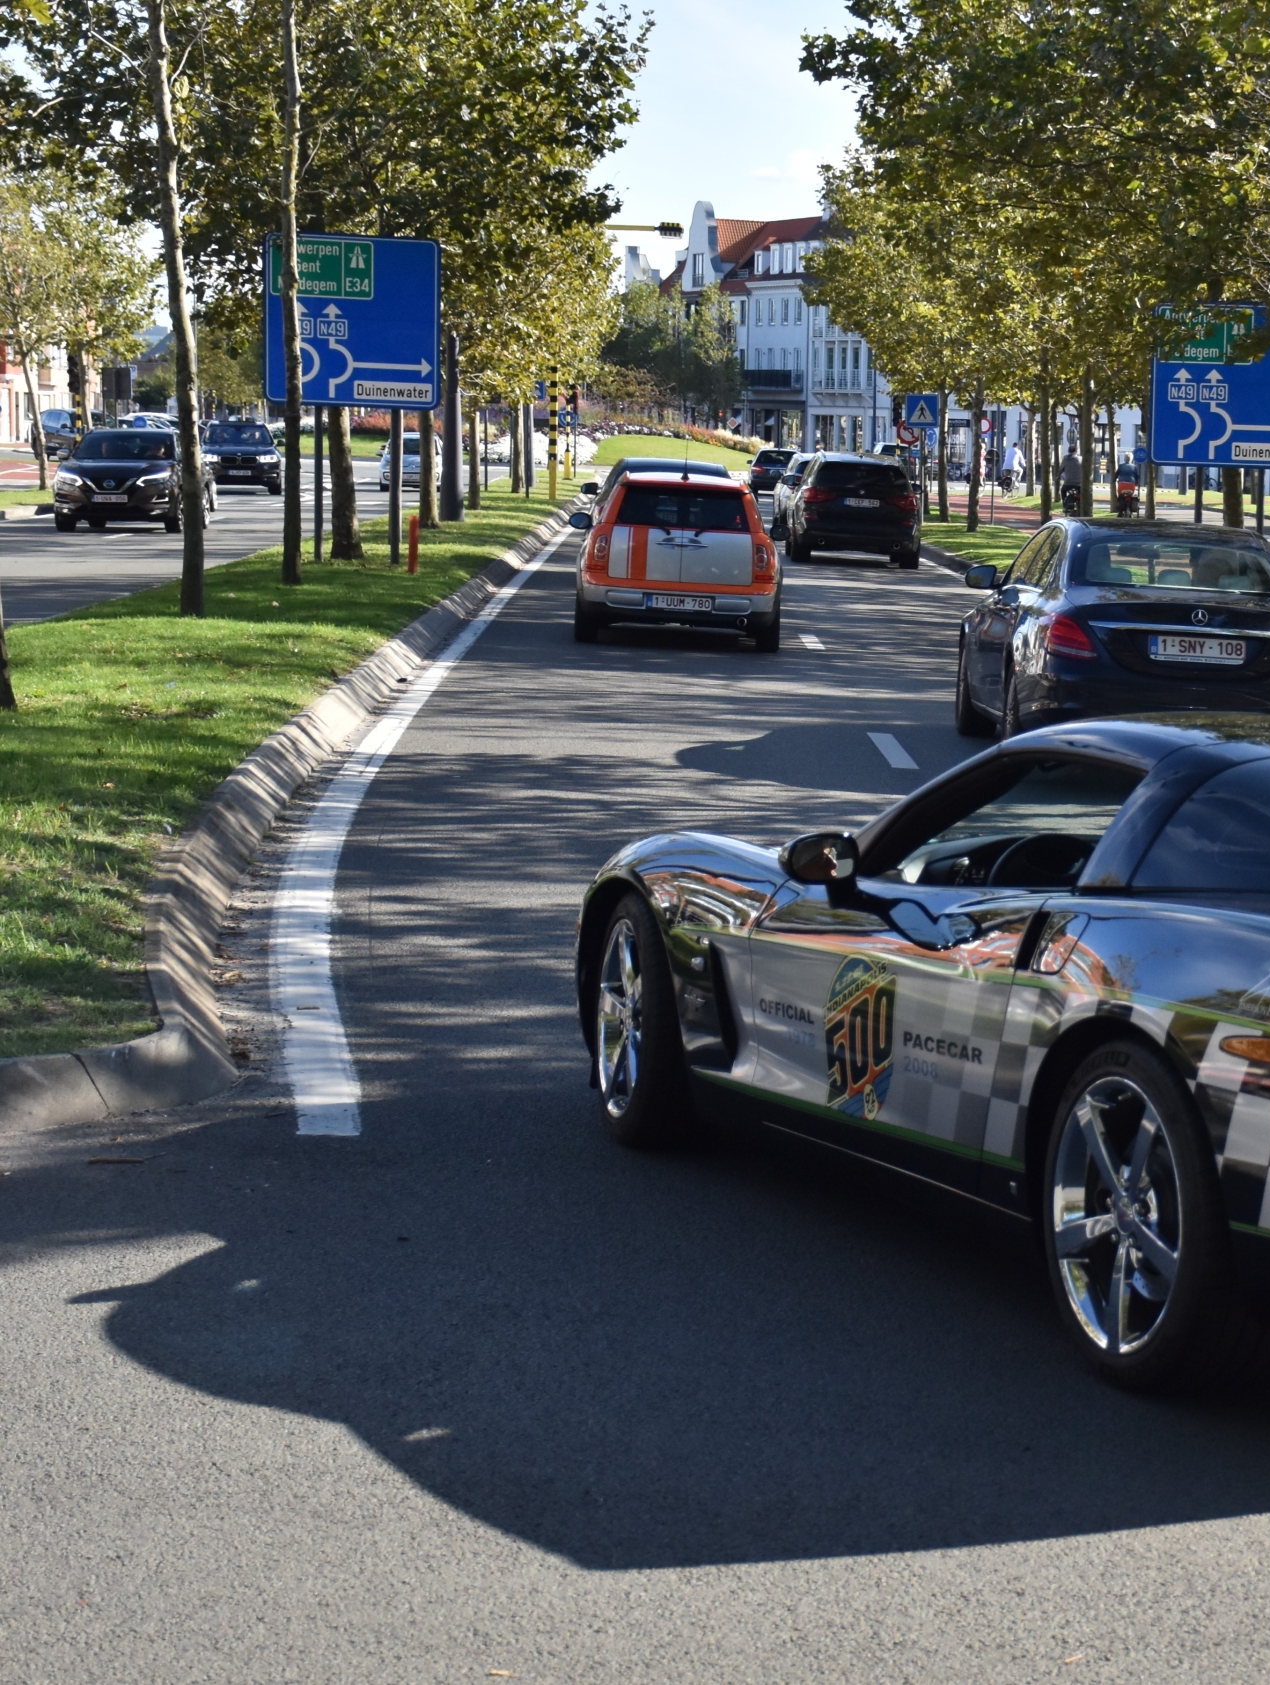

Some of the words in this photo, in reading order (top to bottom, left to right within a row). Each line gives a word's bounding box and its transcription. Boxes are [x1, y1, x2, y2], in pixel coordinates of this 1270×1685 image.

[346, 278, 369, 292] E34
[320, 324, 345, 336] N49
[356, 383, 430, 399] Duinenwater
[1171, 386, 1194, 399] N49
[1202, 388, 1225, 400] N49
[655, 596, 711, 609] 1-UUM-780
[1161, 638, 1243, 656] 1-SNY-108
[759, 998, 815, 1025] OFFICIAL
[825, 975, 897, 1104] 500
[903, 1030, 984, 1065] PACECAR
[903, 1056, 939, 1079] 2008
